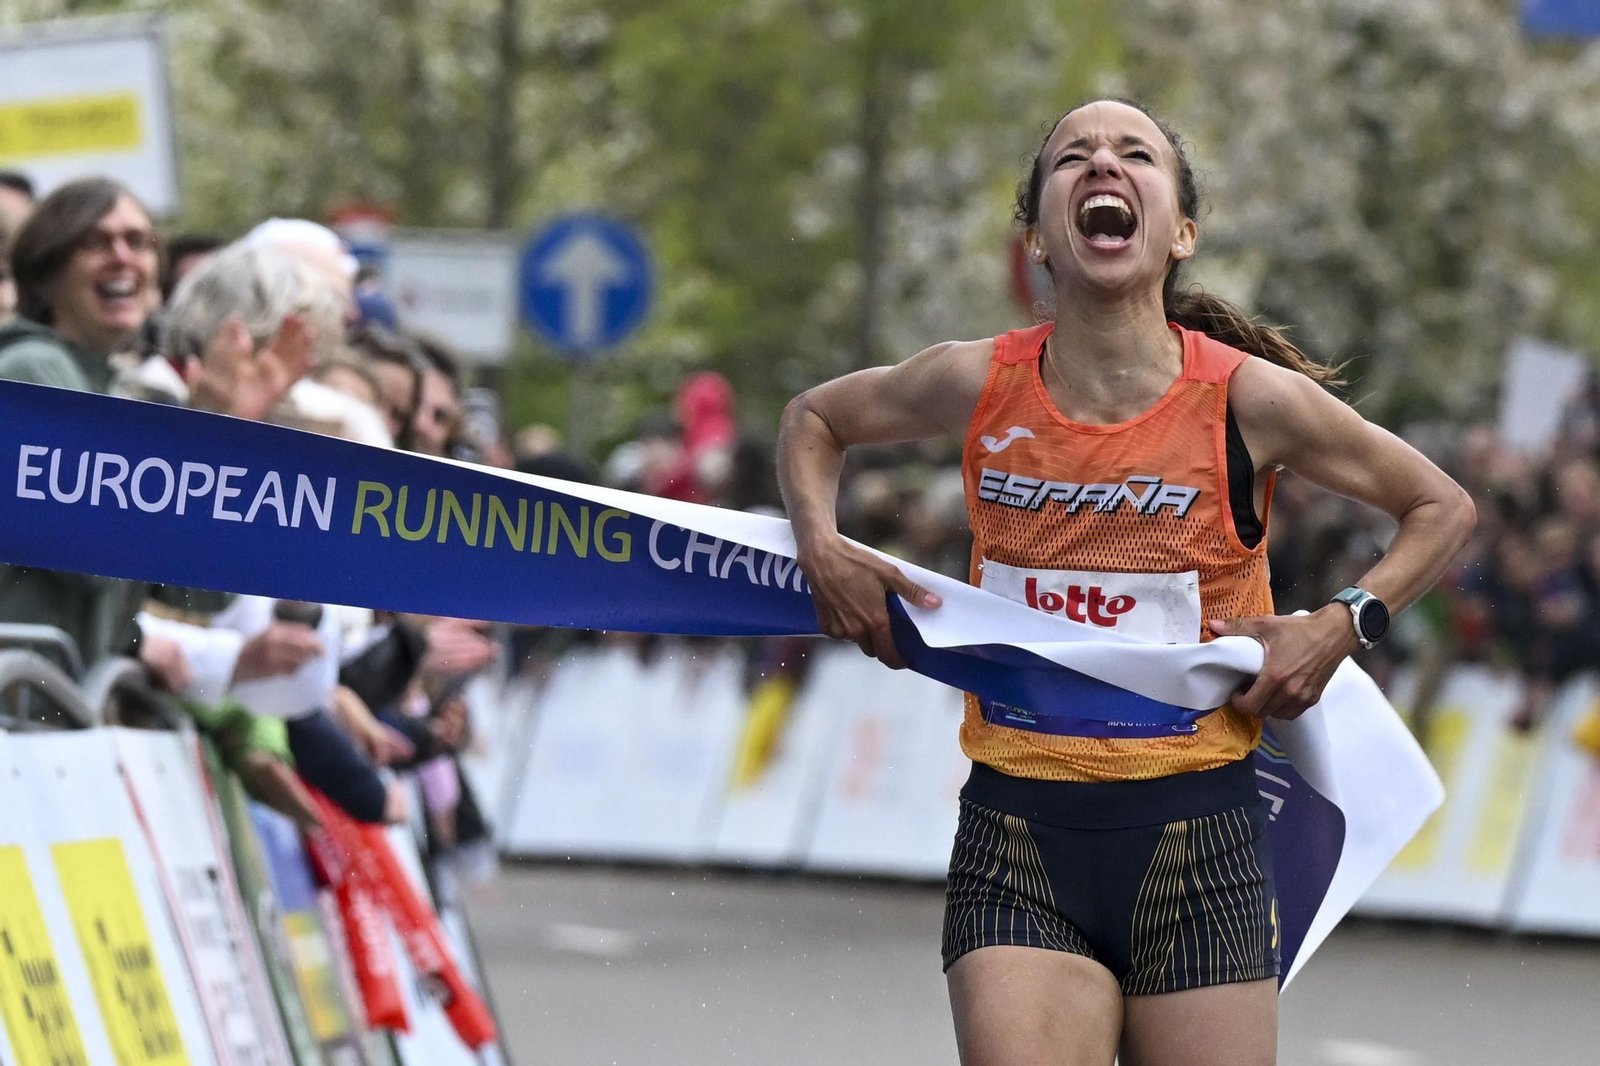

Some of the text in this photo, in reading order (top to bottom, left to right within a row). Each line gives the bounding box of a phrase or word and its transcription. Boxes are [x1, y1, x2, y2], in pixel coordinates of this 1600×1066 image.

[979, 468, 1201, 518] ESPAÑA
[16, 445, 812, 595] EUROPEAN RUNNING CHAM
[1025, 577, 1137, 627] lotto
